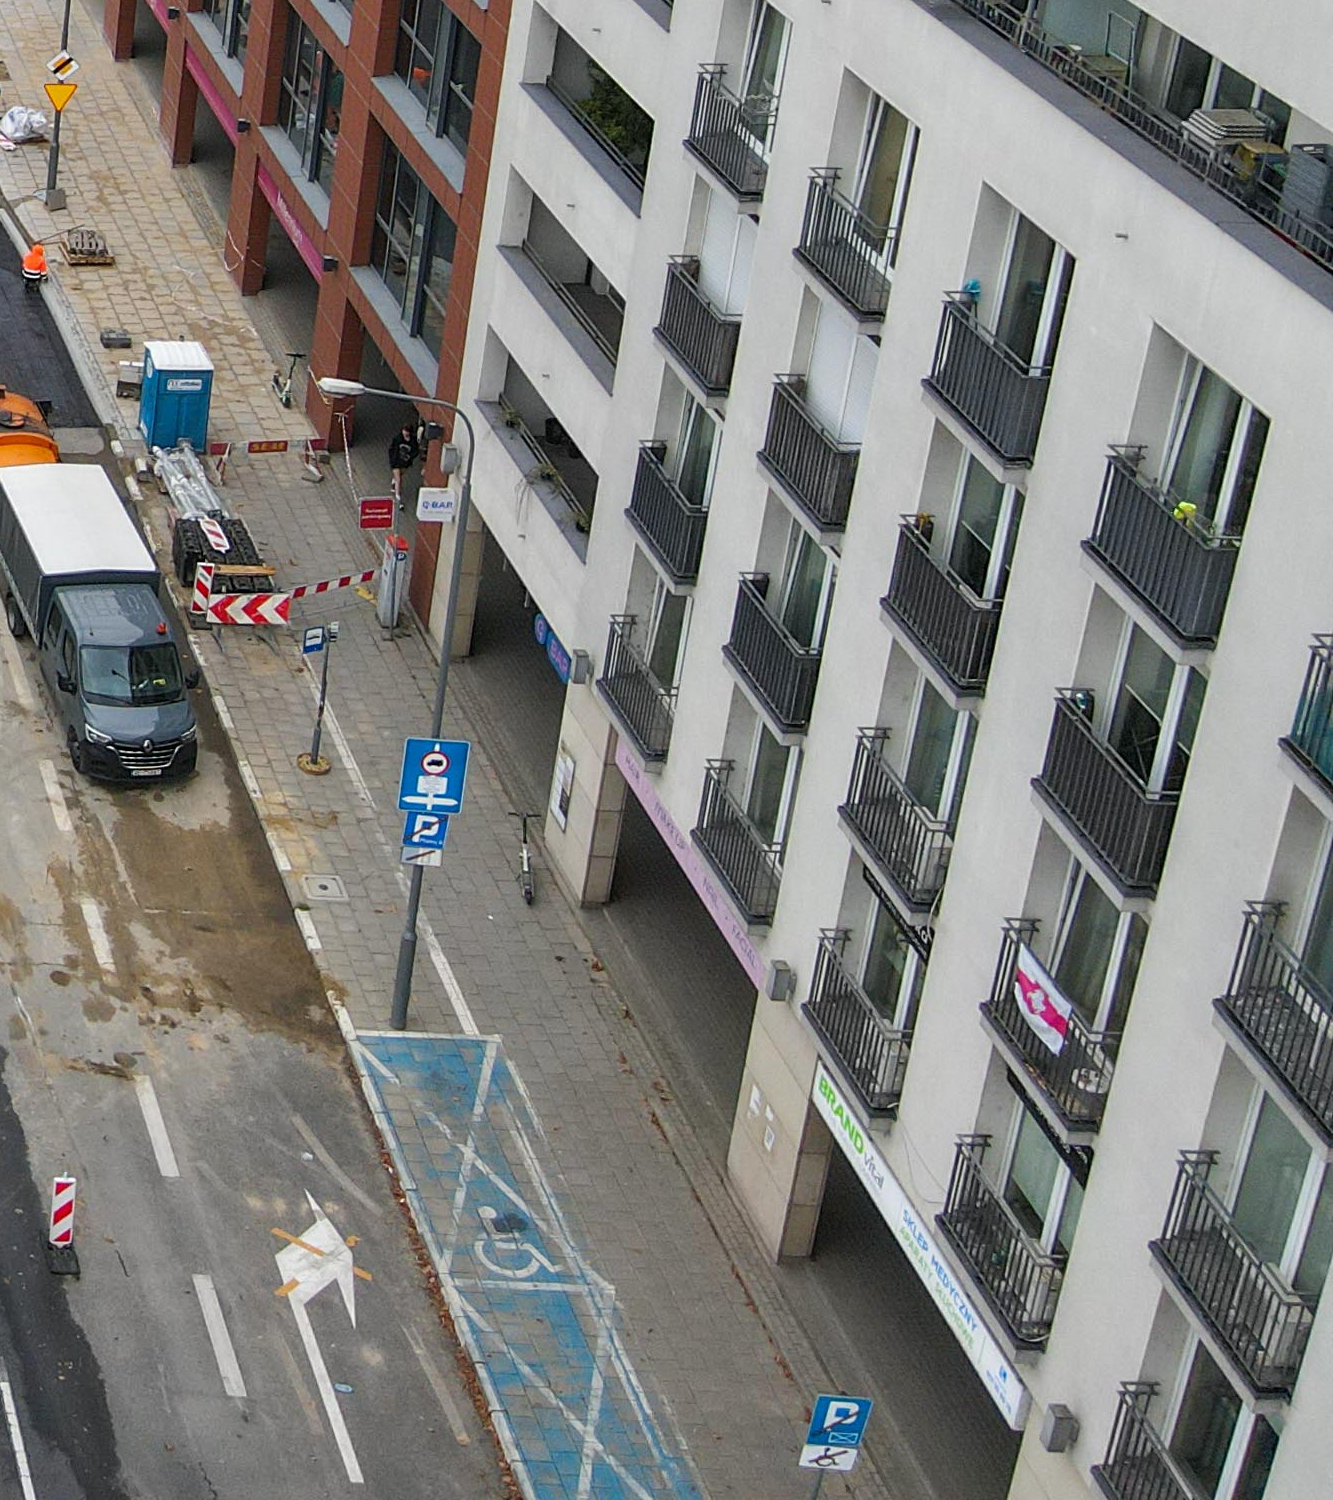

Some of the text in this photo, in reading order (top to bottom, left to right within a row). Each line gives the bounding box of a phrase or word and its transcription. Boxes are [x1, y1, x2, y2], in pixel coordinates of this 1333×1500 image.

[412, 814, 440, 843] P
[818, 1074, 865, 1155] BRAND
[902, 1209, 979, 1333] SKLEP MEDYCZNY
[823, 1400, 860, 1432] P
